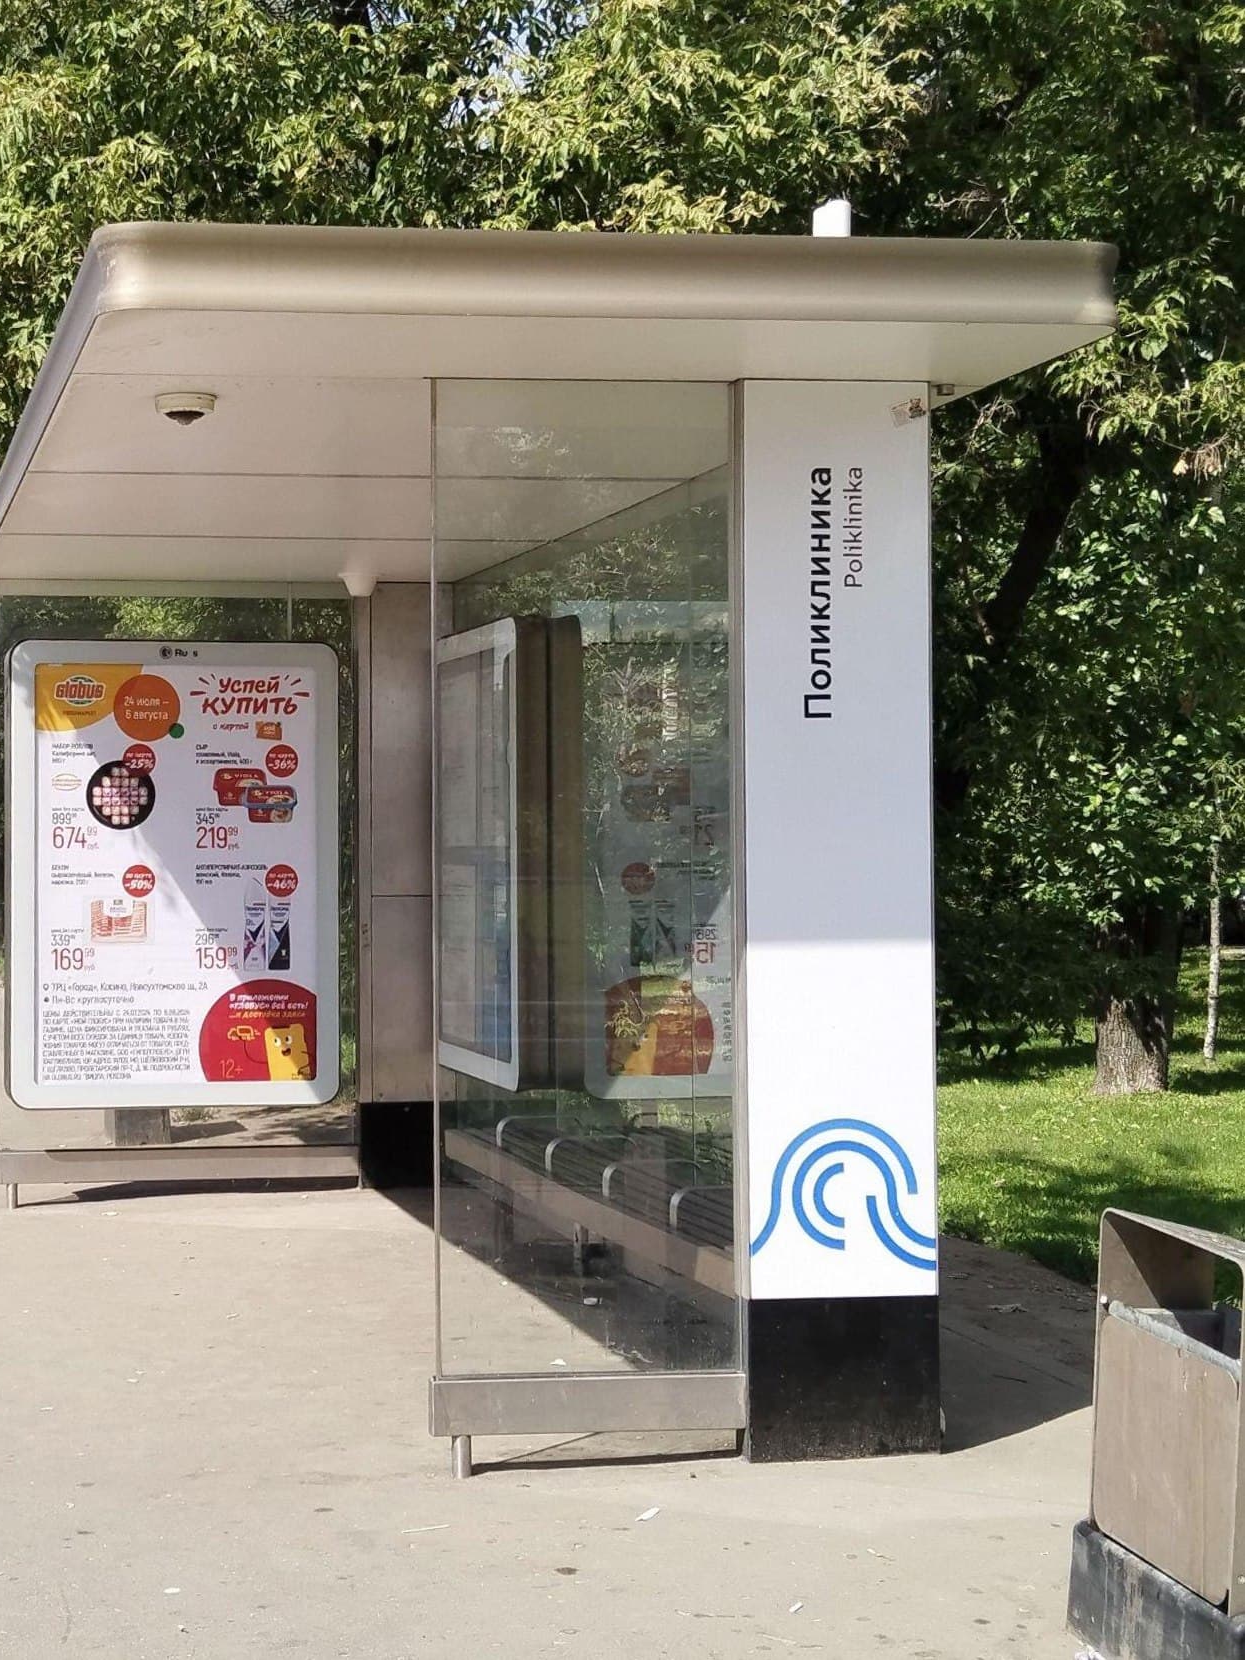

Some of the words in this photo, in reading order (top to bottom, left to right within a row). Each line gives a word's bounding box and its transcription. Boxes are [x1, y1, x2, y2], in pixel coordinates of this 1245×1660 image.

[843, 467, 863, 588] Poliklinika
[804, 467, 832, 719] Поликлиника
[218, 675, 280, 694] Успей
[124, 696, 135, 706] 24
[137, 698, 160, 707] июля
[202, 696, 298, 716] КУПИТЬ
[126, 709, 132, 719] 6
[134, 711, 169, 721] августа
[125, 759, 154, 769] -25%
[268, 759, 296, 770] -36%
[52, 813, 71, 824] 899
[196, 813, 215, 824] 345
[53, 826, 87, 849] 674
[196, 826, 228, 849] 219
[228, 826, 238, 836] 99
[125, 879, 153, 890] -50%
[268, 879, 296, 890] -46%
[51, 934, 70, 946] 339
[51, 947, 84, 970] 169
[196, 947, 227, 969] 159
[219, 1059, 243, 1079] 12+
